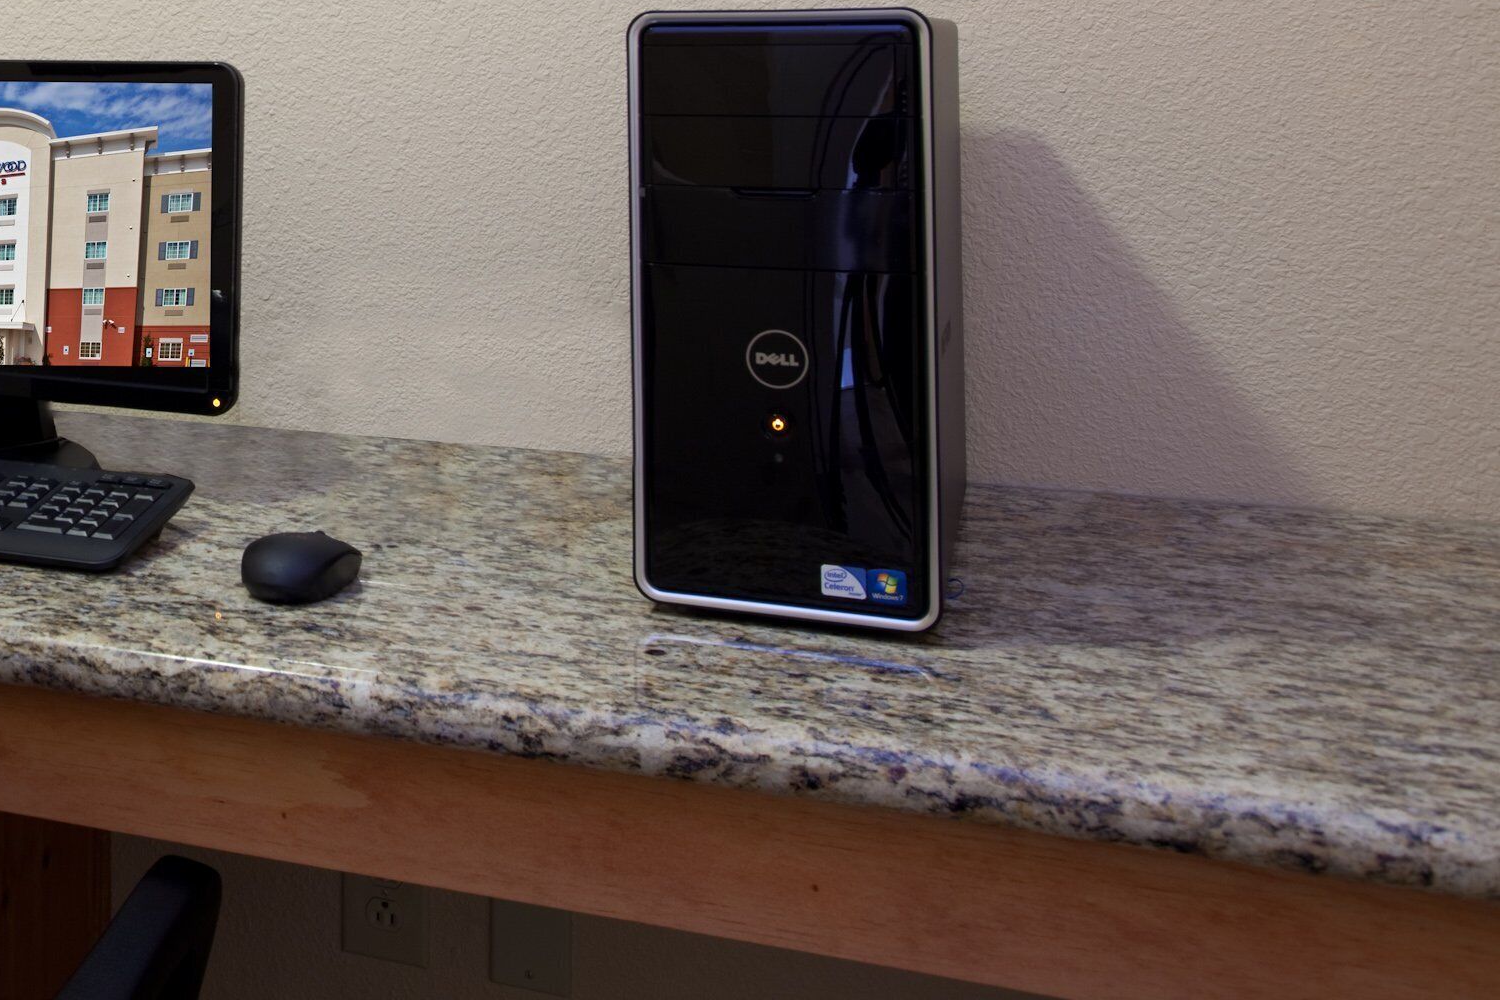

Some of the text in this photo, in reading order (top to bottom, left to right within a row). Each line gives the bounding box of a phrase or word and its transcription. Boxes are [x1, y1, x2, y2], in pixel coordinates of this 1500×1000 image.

[755, 351, 799, 367] DELL
[824, 582, 854, 592] Celeron
[872, 593, 899, 601] Windows
